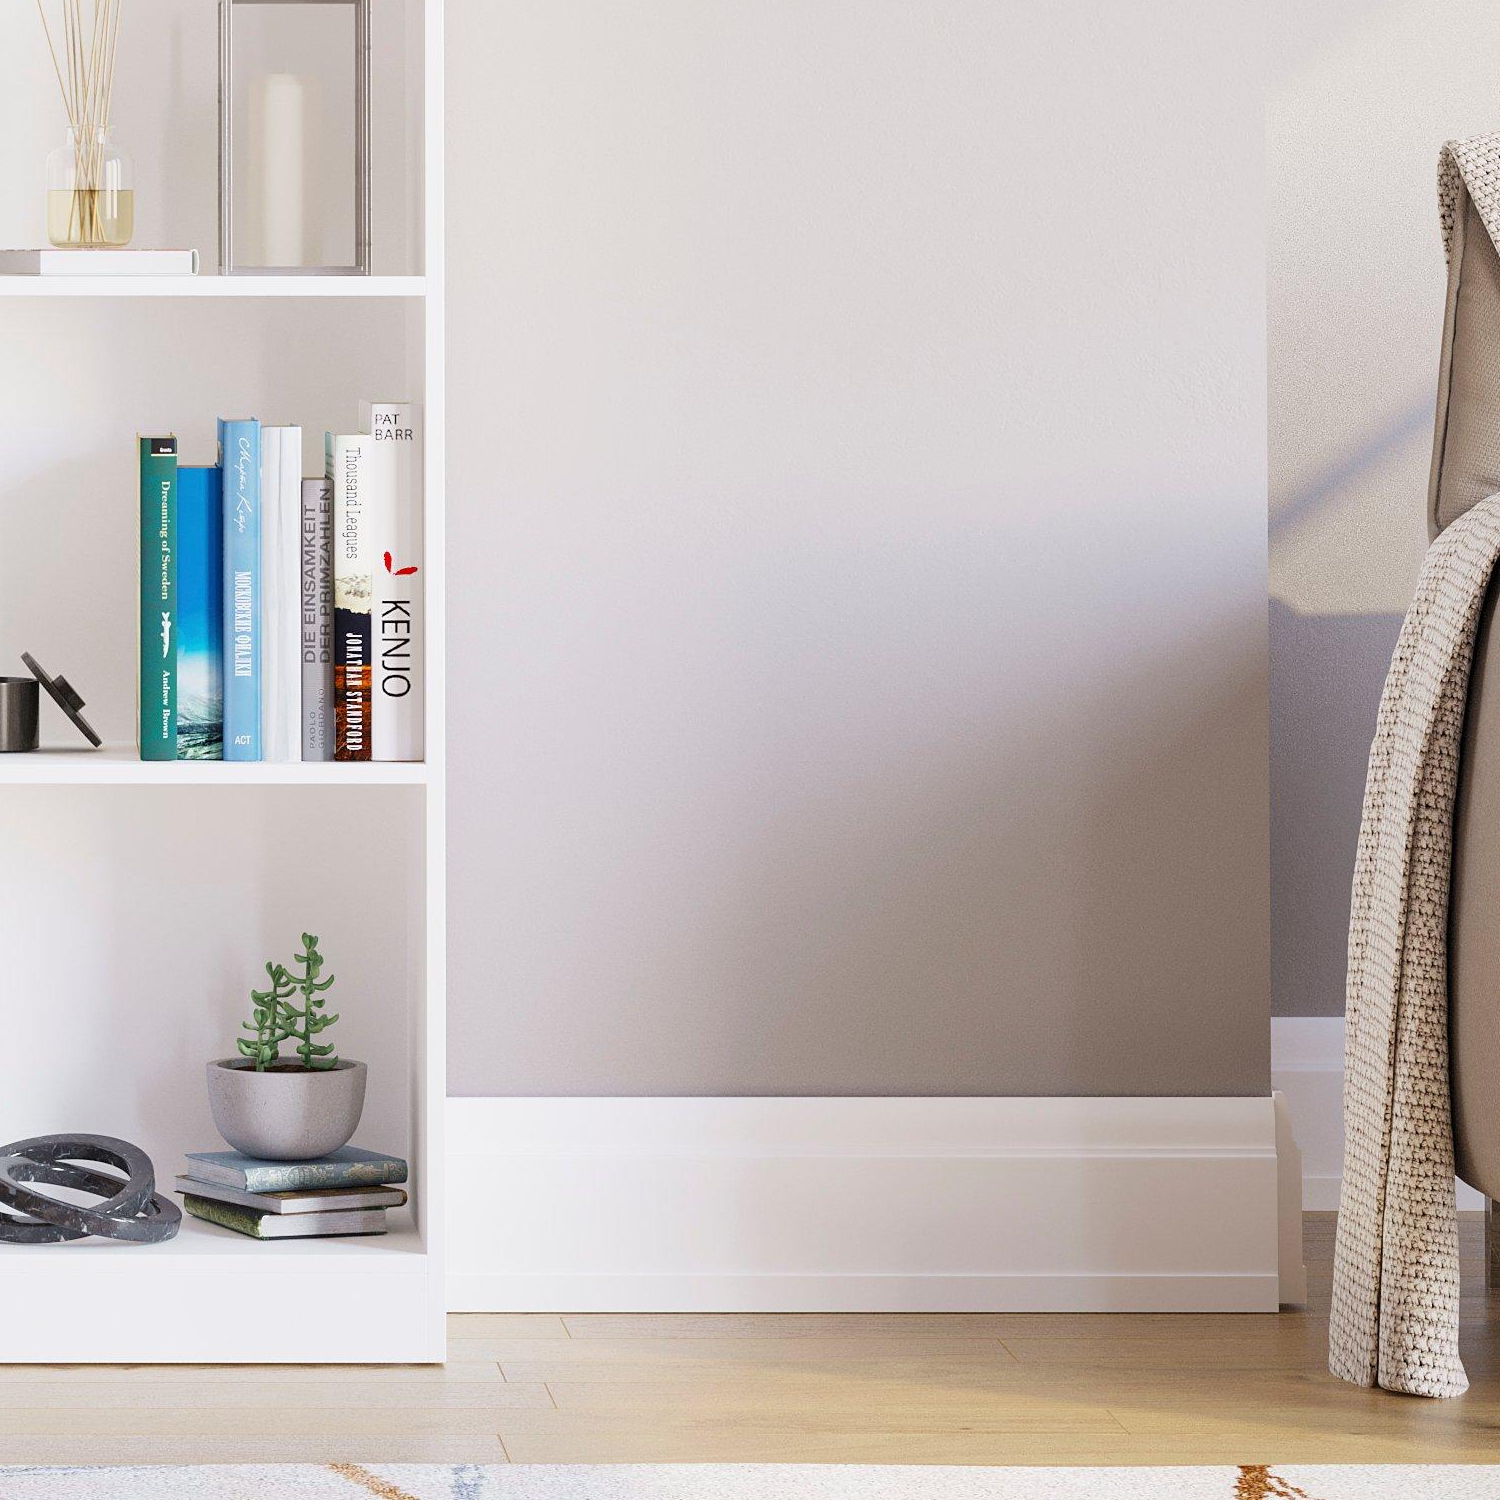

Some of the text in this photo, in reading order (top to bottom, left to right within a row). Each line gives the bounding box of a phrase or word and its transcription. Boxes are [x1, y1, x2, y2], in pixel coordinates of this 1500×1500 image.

[374, 413, 400, 426] PAT
[374, 428, 414, 441] BARR
[159, 480, 171, 600] Dreaming of Sweden
[343, 447, 362, 559] Thousand Leagues
[304, 504, 316, 664] DIE EINSAMKEIT
[319, 487, 331, 664] DER PRIMZAHLEN
[162, 670, 171, 739] Andrew Brown
[345, 632, 363, 751] JONATHAN STANDFORD
[381, 600, 411, 698] KENJO
